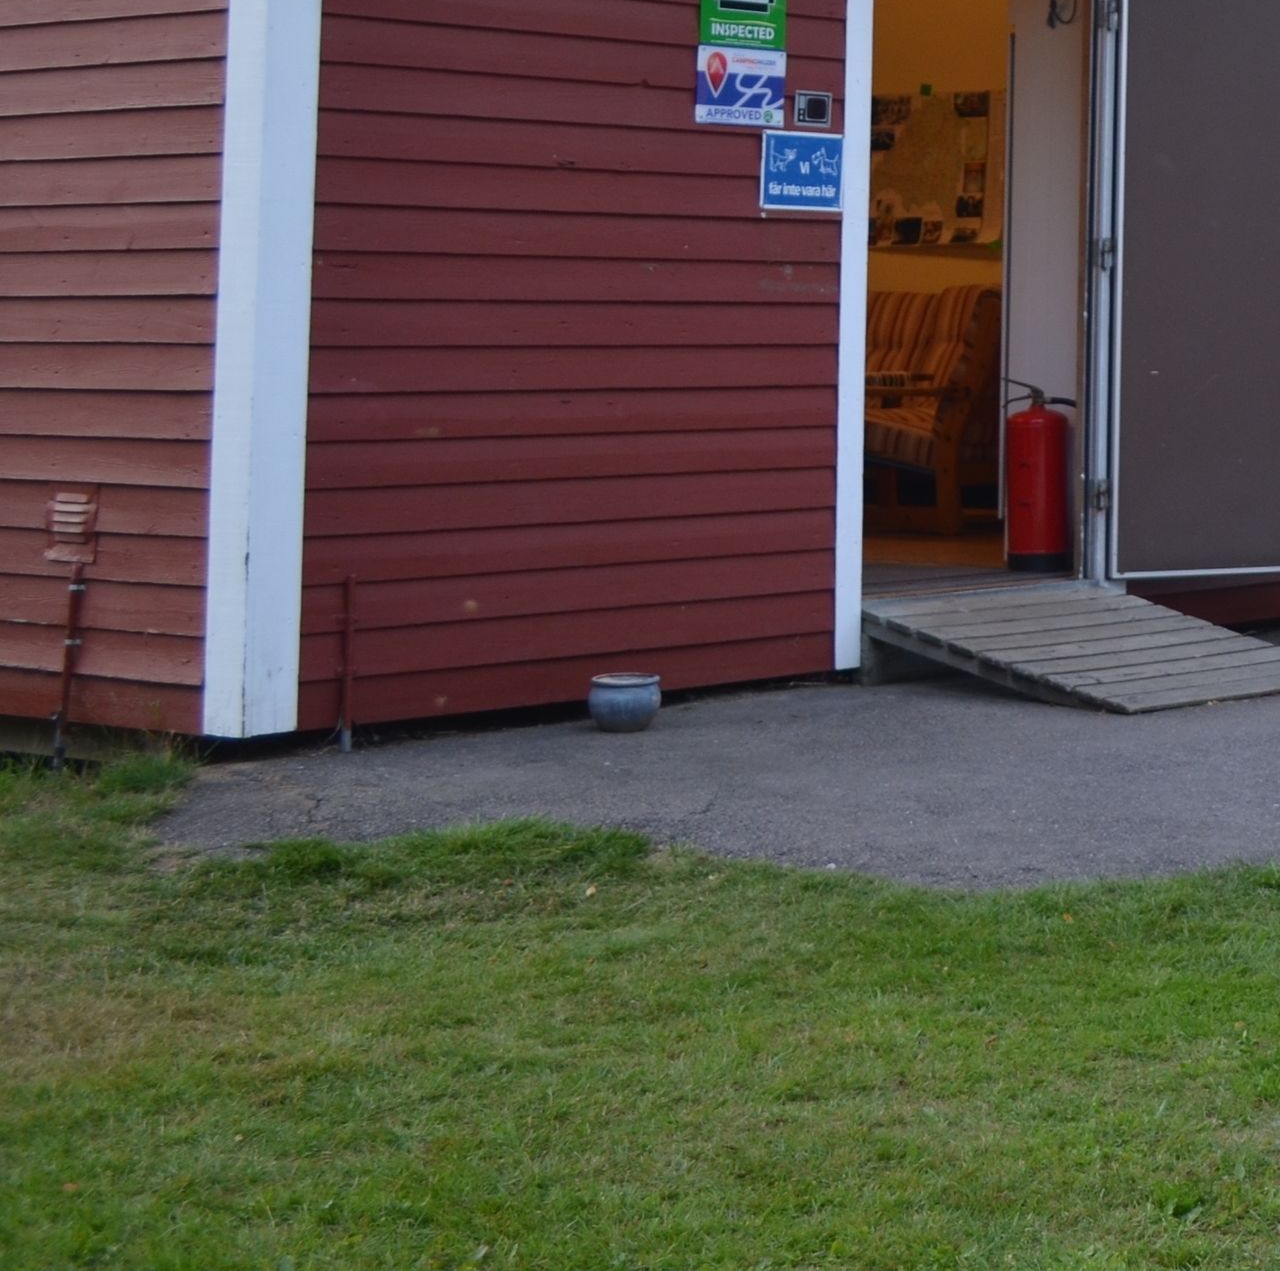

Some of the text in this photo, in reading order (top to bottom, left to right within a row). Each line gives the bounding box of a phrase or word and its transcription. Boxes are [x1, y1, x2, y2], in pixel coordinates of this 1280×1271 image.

[711, 23, 775, 40] INSPECTED
[705, 108, 762, 121] APPROVED
[783, 182, 800, 196] inte
[801, 185, 820, 196] vara
[821, 184, 837, 197] här
